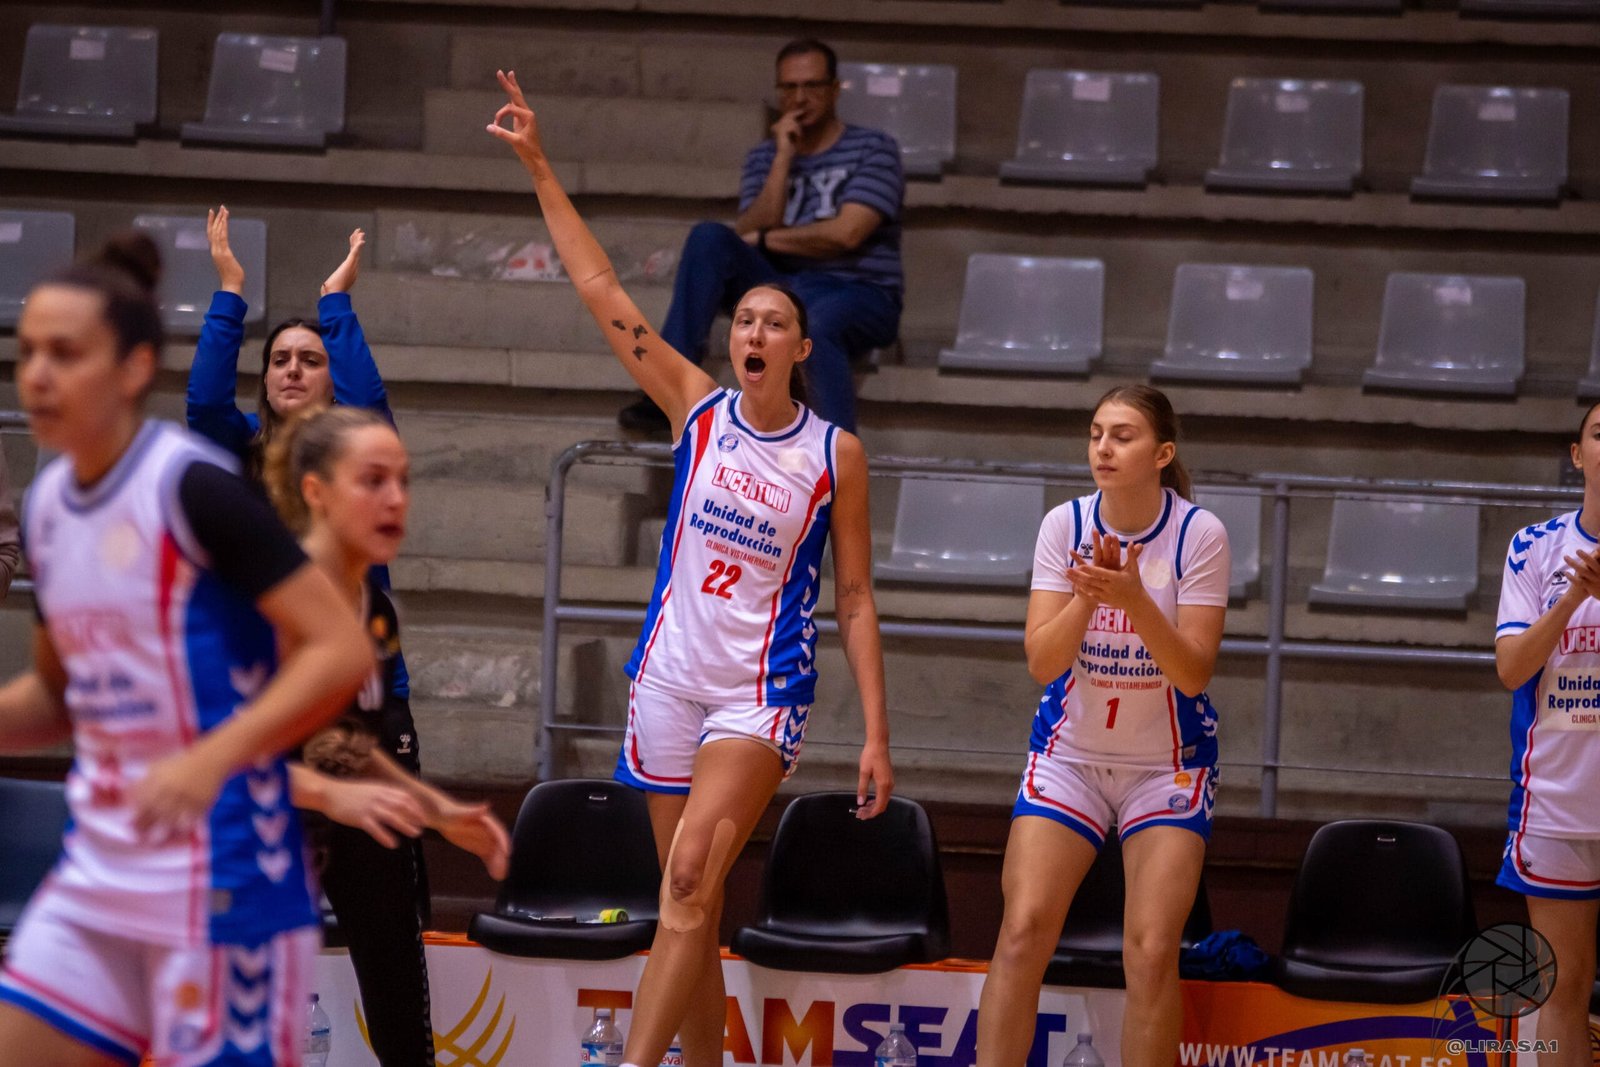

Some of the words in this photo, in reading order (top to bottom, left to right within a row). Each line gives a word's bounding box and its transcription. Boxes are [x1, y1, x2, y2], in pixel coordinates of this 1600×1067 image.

[712, 463, 791, 513] LUCENTUM
[690, 513, 782, 558] Reproducción
[703, 499, 755, 529] Unidad
[758, 521, 776, 538] de
[730, 547, 777, 571] VISTAHERMOSA
[701, 559, 742, 600] 22
[1077, 655, 1163, 677] eproducción
[1081, 641, 1130, 659] Unidad
[1105, 697, 1120, 729] 1
